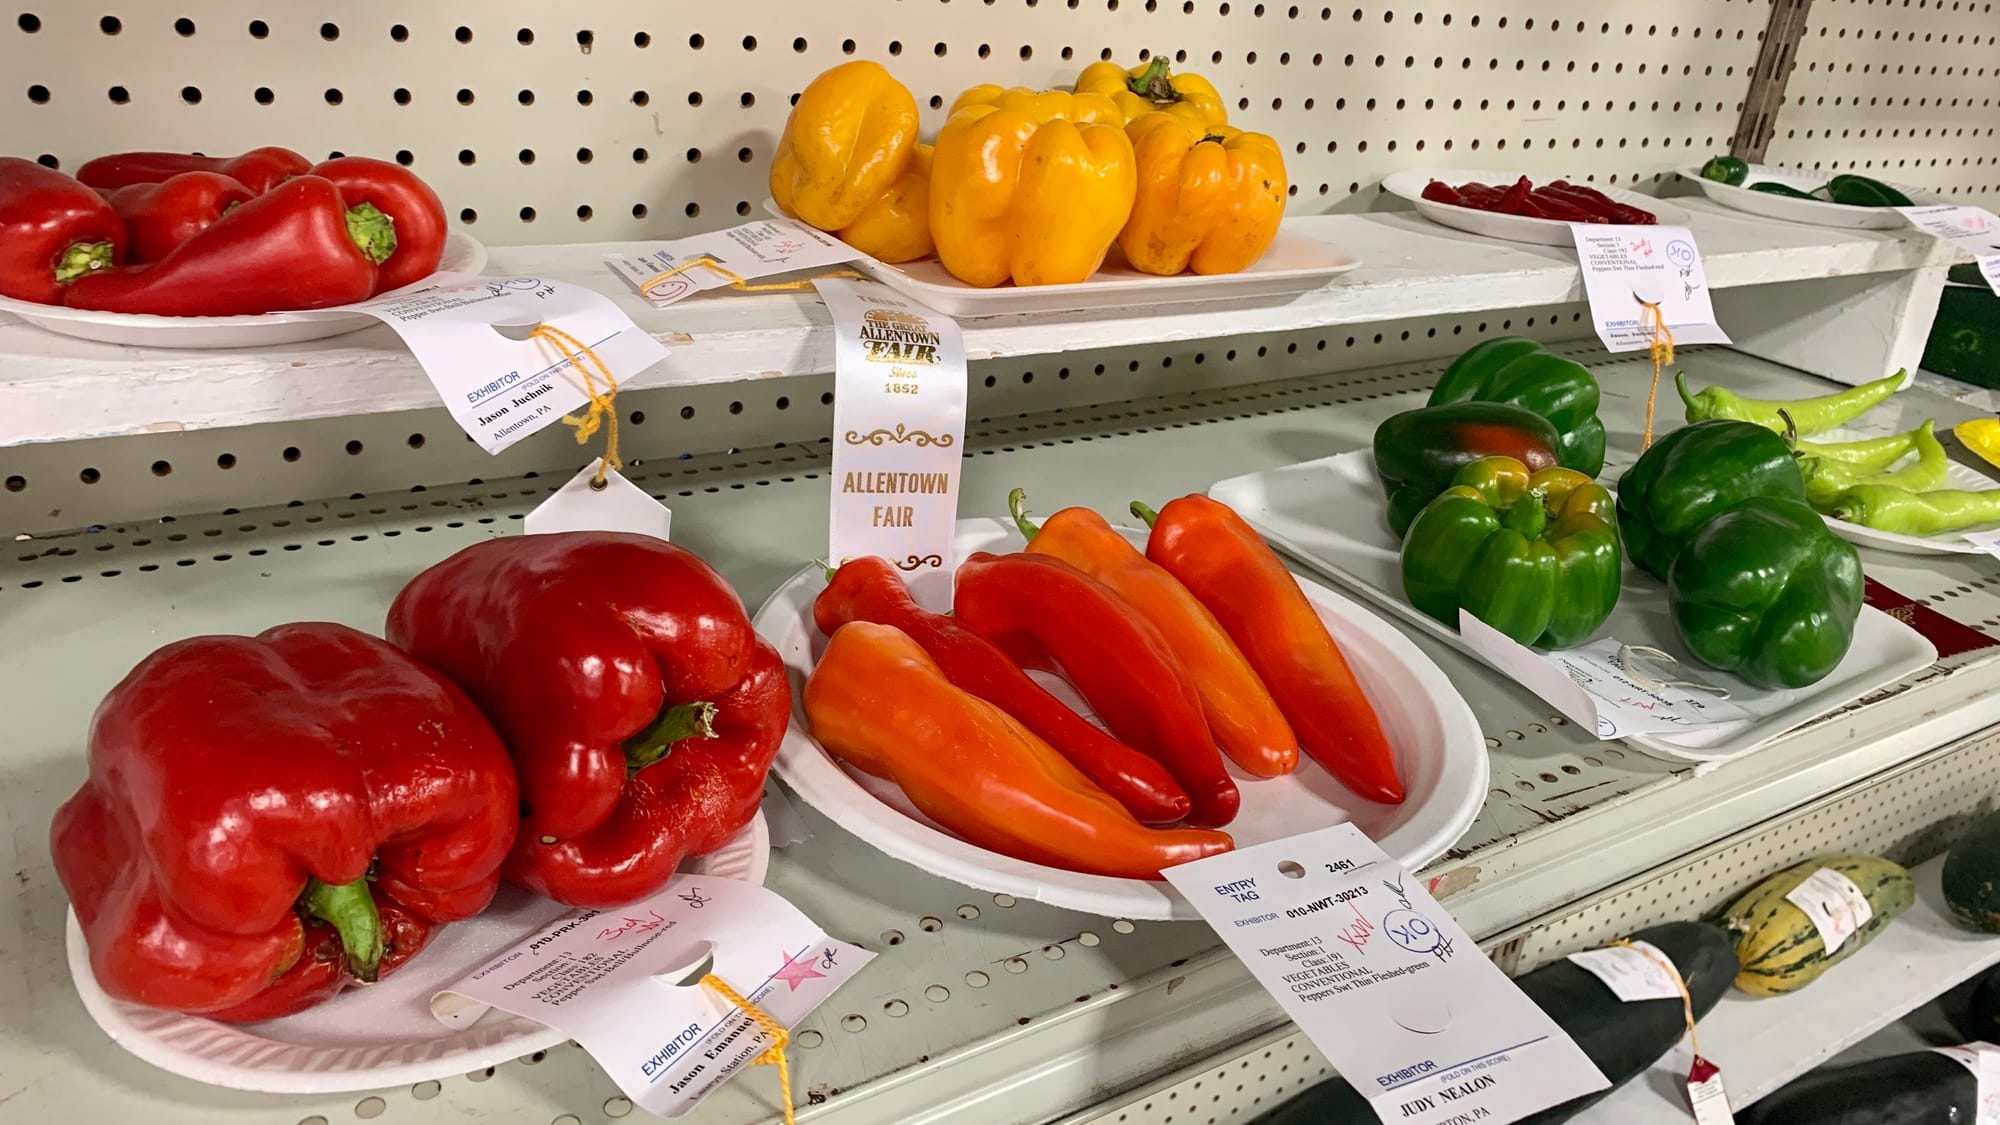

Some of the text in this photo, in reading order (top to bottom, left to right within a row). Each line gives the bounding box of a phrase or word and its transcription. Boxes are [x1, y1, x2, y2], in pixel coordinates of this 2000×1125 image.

[859, 325, 941, 346] ALLENTOWN
[866, 319, 928, 333] THE GREAT
[1605, 320, 1639, 328] EXHIBITOR
[863, 340, 942, 364] FAIR
[466, 370, 521, 404] EXHIBITOR
[884, 383, 919, 395] 1852
[477, 382, 554, 427] Jason Juchnik
[493, 404, 553, 441] Allentown, PA
[842, 471, 949, 495] ALLENTOWN
[872, 506, 915, 528] FAIR
[1324, 859, 1356, 874] 2461
[1214, 877, 1258, 896] ENTRY
[1230, 890, 1260, 904] TAG
[1286, 885, 1370, 919] 010-NWT-30213
[1233, 912, 1281, 929] EXHIBITOR
[1259, 936, 1323, 958] Department: 13
[1287, 949, 1321, 963] Section:
[472, 951, 525, 981] EXHIBITOR
[503, 951, 573, 991] Department: 13
[531, 961, 570, 983] Section:
[552, 962, 580, 981] Class:
[1281, 961, 1351, 984] VEGETABLES
[1301, 952, 1344, 970] Class: 191
[531, 955, 606, 1000] VEGETABLES
[541, 947, 629, 1004] CONVENTIONAL
[1290, 967, 1374, 994] CONVENTIONAL
[1299, 960, 1430, 1004] Peppers Swt Thin Fleshed-green
[551, 984, 587, 1007] Pepper
[705, 1027, 726, 1045] (FOLD
[724, 1017, 737, 1028] ON
[641, 1022, 703, 1077] EXHIBITOR
[667, 1016, 756, 1094] Jason Emanuel
[720, 1044, 758, 1075] Station,
[752, 1030, 770, 1045] PA
[1376, 1059, 1439, 1087] EXHIBITOR
[1440, 1054, 1512, 1084] (FOLD ON THIS SCORE)
[1400, 1074, 1497, 1118] JUDY NEALON
[1472, 1106, 1491, 1119] PA
